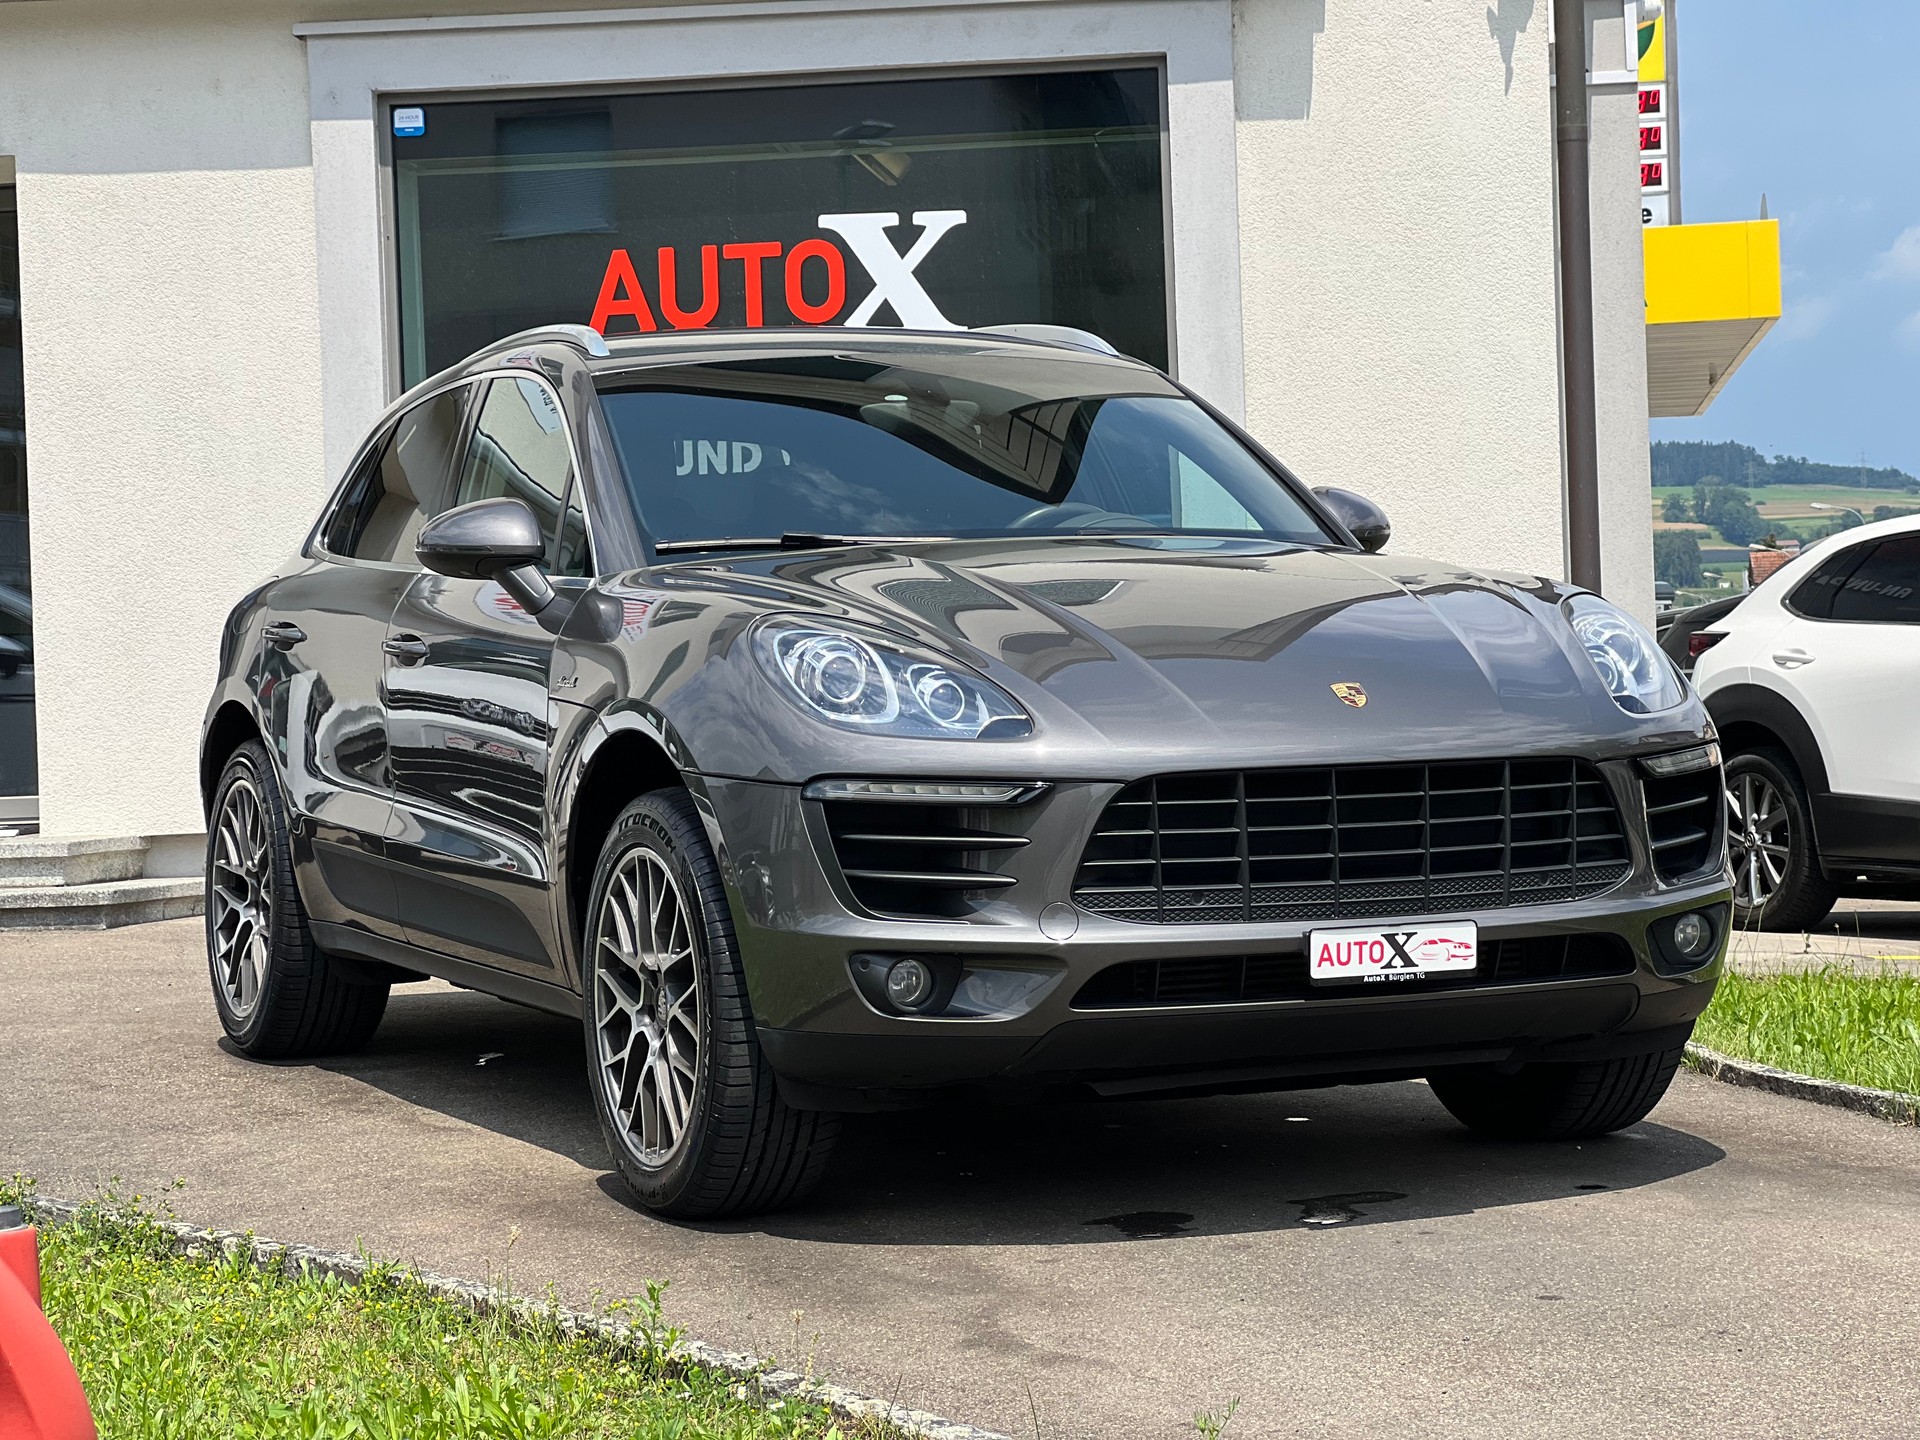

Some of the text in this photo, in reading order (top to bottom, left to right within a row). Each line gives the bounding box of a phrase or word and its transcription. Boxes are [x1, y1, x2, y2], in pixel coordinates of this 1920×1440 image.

[1317, 931, 1419, 969] AUTOX
[1363, 972, 1426, 983] AutoX Bürglen TG
